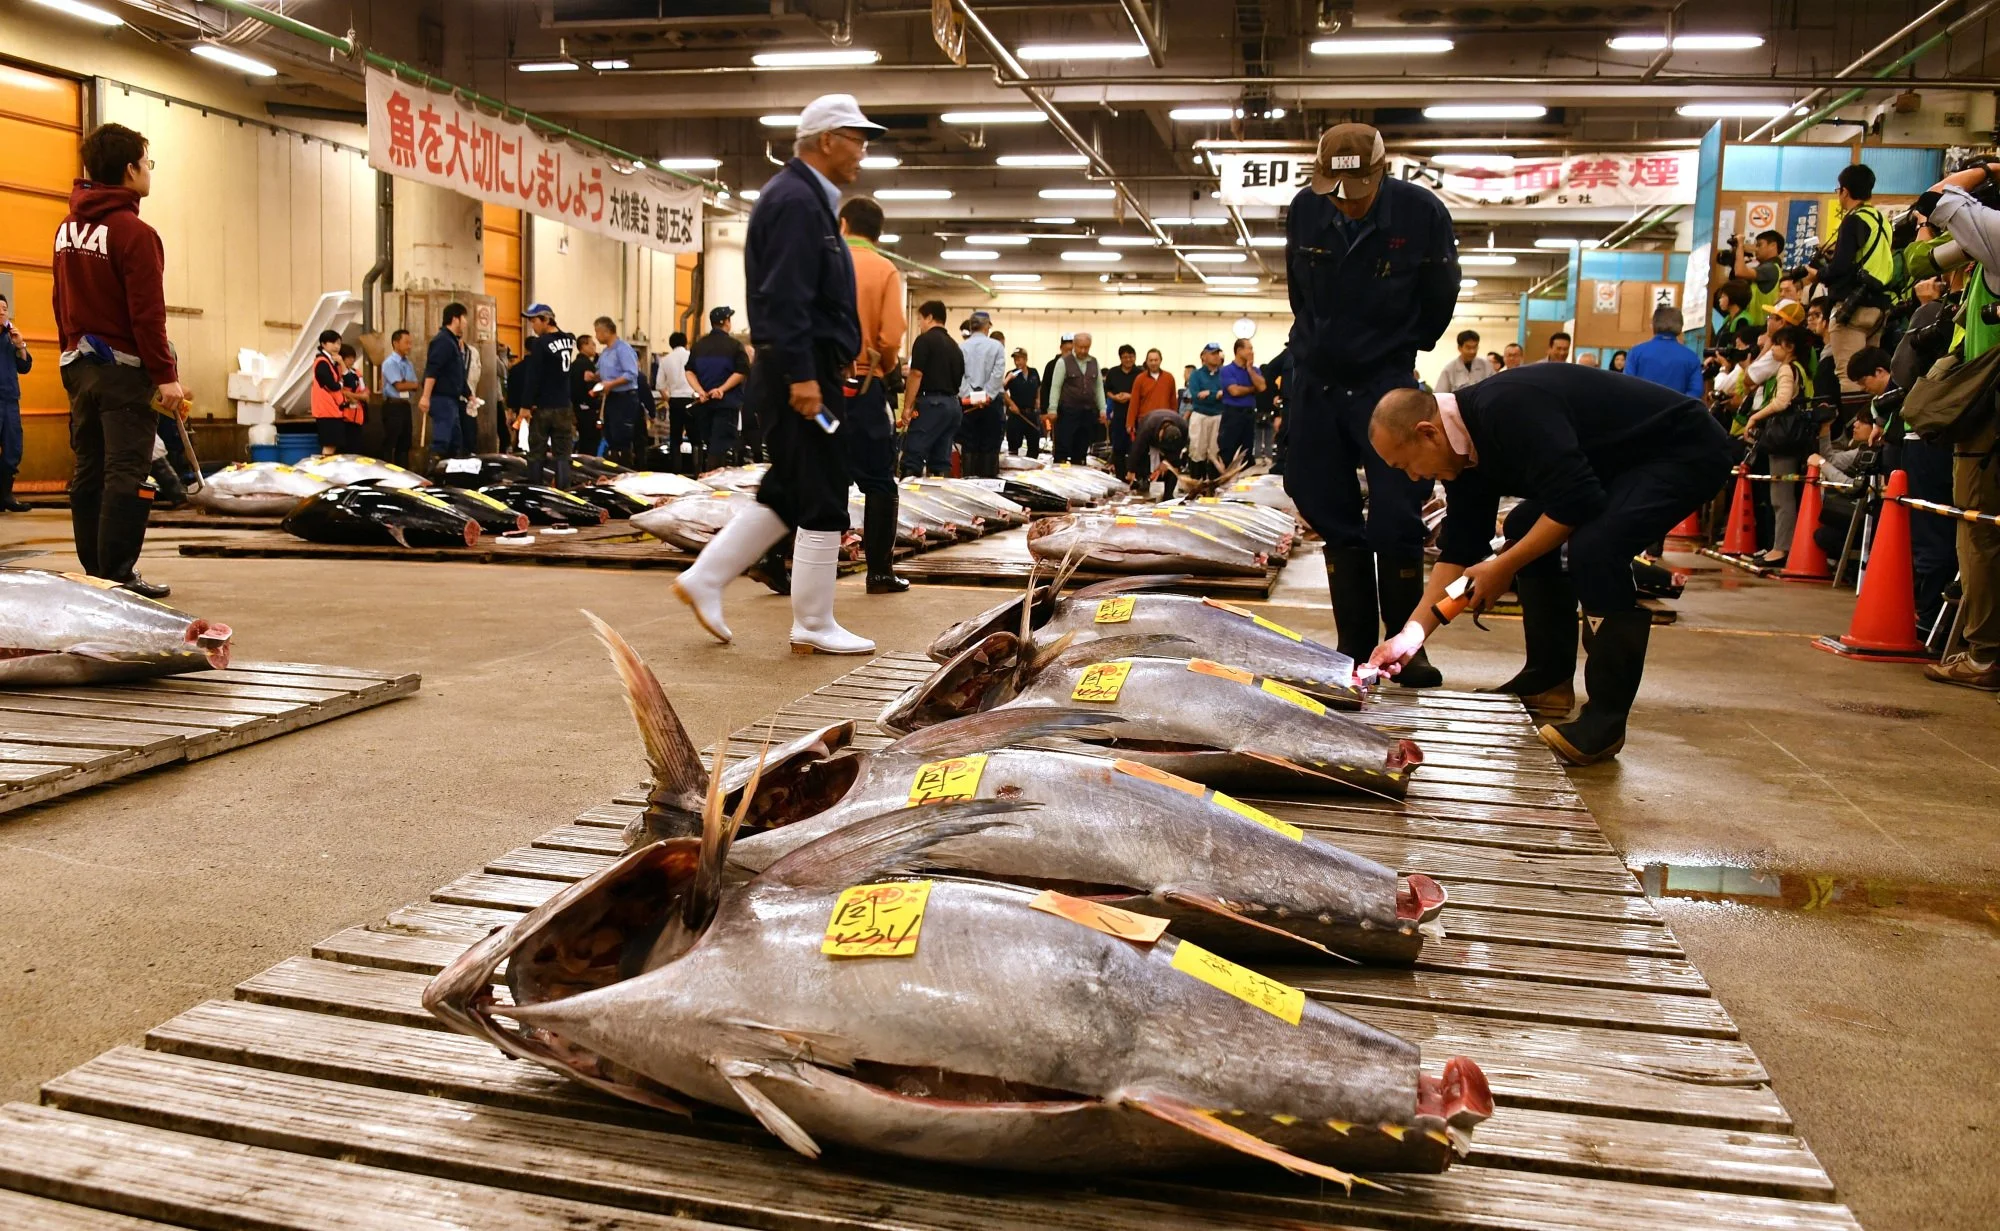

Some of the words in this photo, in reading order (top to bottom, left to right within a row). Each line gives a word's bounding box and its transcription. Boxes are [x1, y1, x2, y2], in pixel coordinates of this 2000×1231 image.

[387, 89, 605, 223] 魚を大切にしましょう
[610, 187, 650, 235] 大物業会
[561, 350, 571, 372] 0
